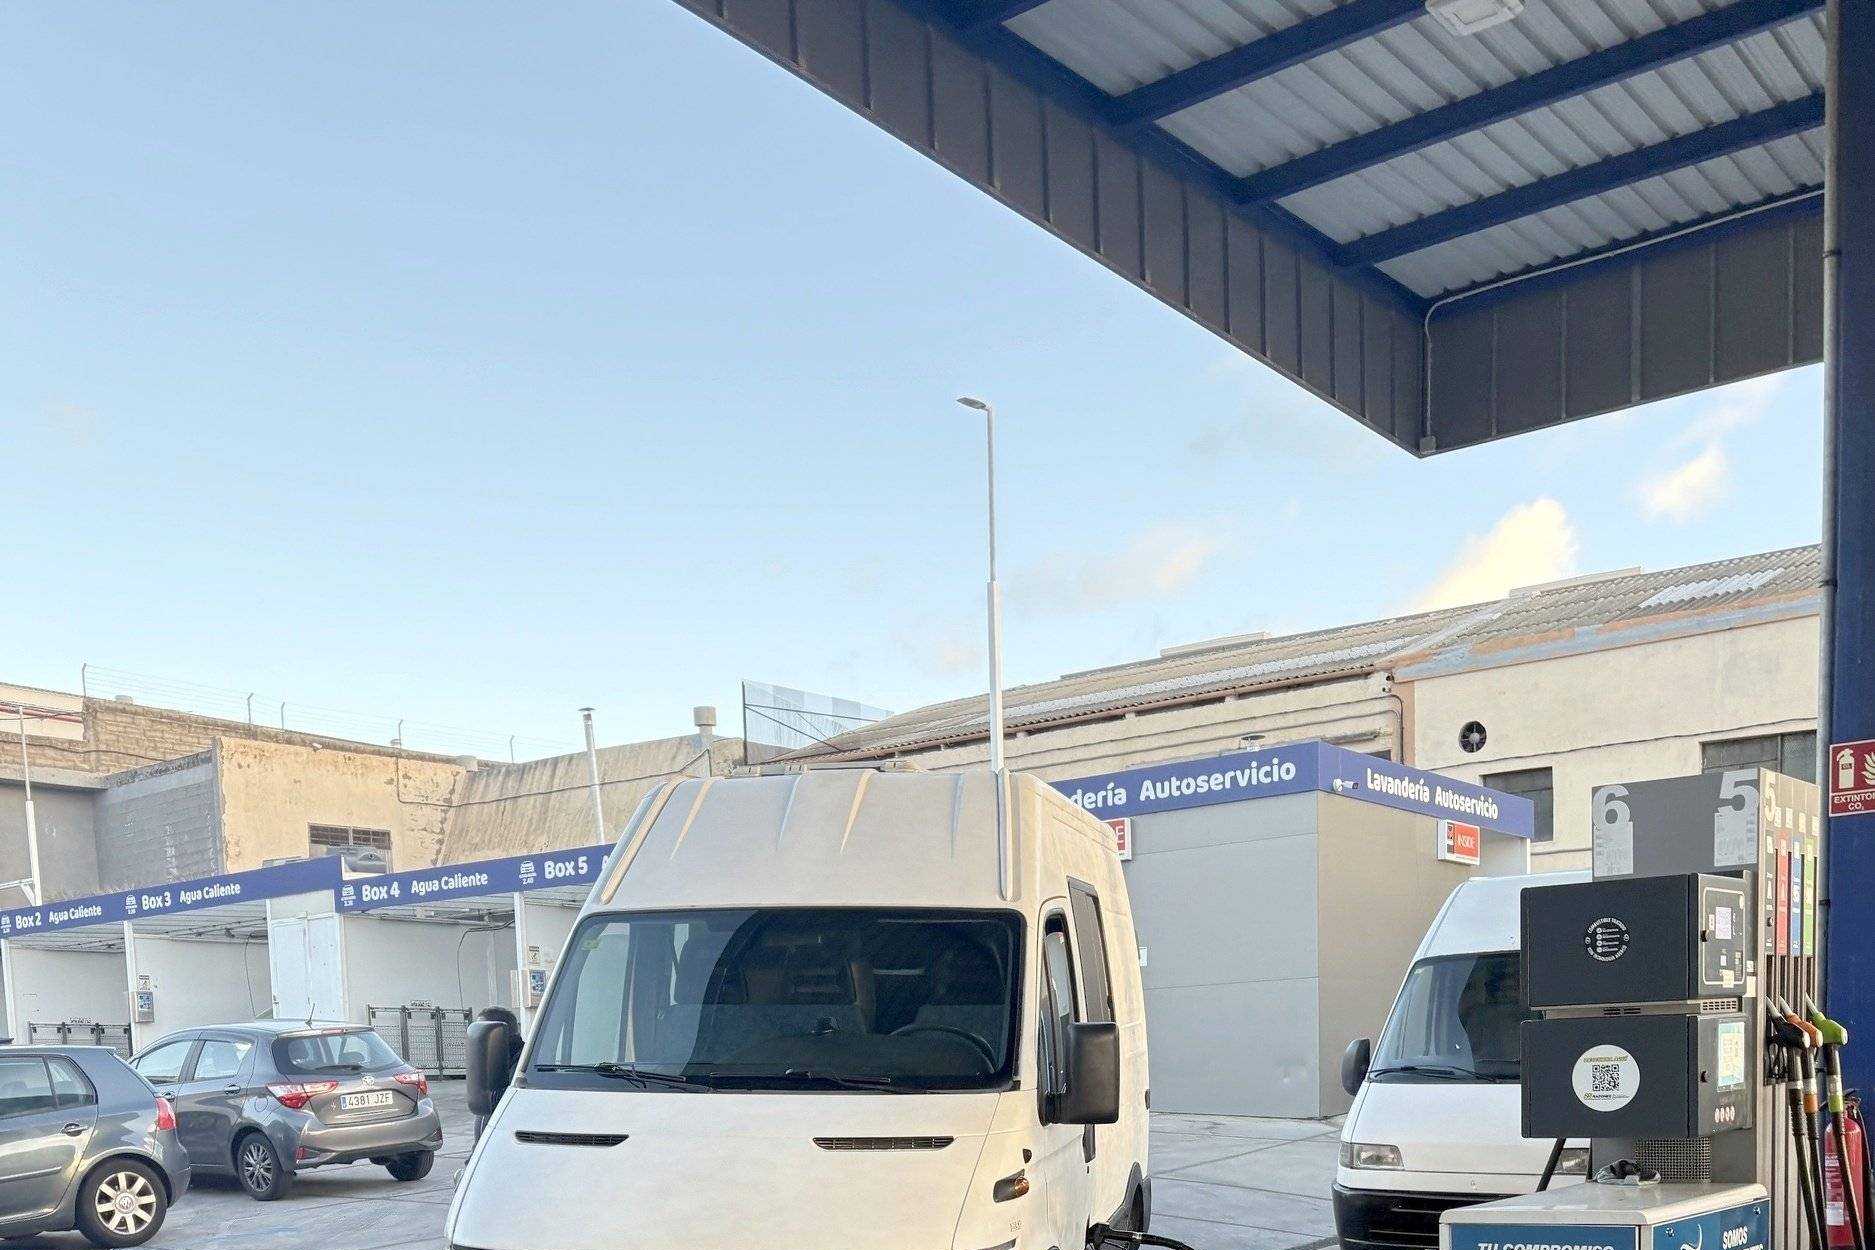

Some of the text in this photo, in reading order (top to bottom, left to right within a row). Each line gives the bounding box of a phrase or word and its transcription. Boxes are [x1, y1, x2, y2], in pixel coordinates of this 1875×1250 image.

[1139, 757, 1296, 801] Autoservicio
[1366, 767, 1499, 819] Lavandería Autoservicio
[1717, 768, 1760, 818] 5
[1592, 784, 1631, 829] 6
[1834, 792, 1875, 804] EXTINTO
[544, 860, 575, 879] Box
[577, 856, 588, 875] 5
[141, 894, 163, 911] Box
[163, 892, 171, 907] 3
[180, 889, 203, 905] Agua
[203, 883, 241, 900] Caliente
[361, 885, 388, 901] Box
[389, 881, 400, 898] 4
[411, 879, 439, 896] Agua
[441, 872, 488, 890] Caliente
[15, 914, 35, 929] Box
[35, 912, 42, 926] 2
[49, 911, 68, 924] Agua
[69, 905, 102, 920] Caliente
[348, 1093, 390, 1107] 4381 JZF
[1722, 1226, 1748, 1250] SOMOS
